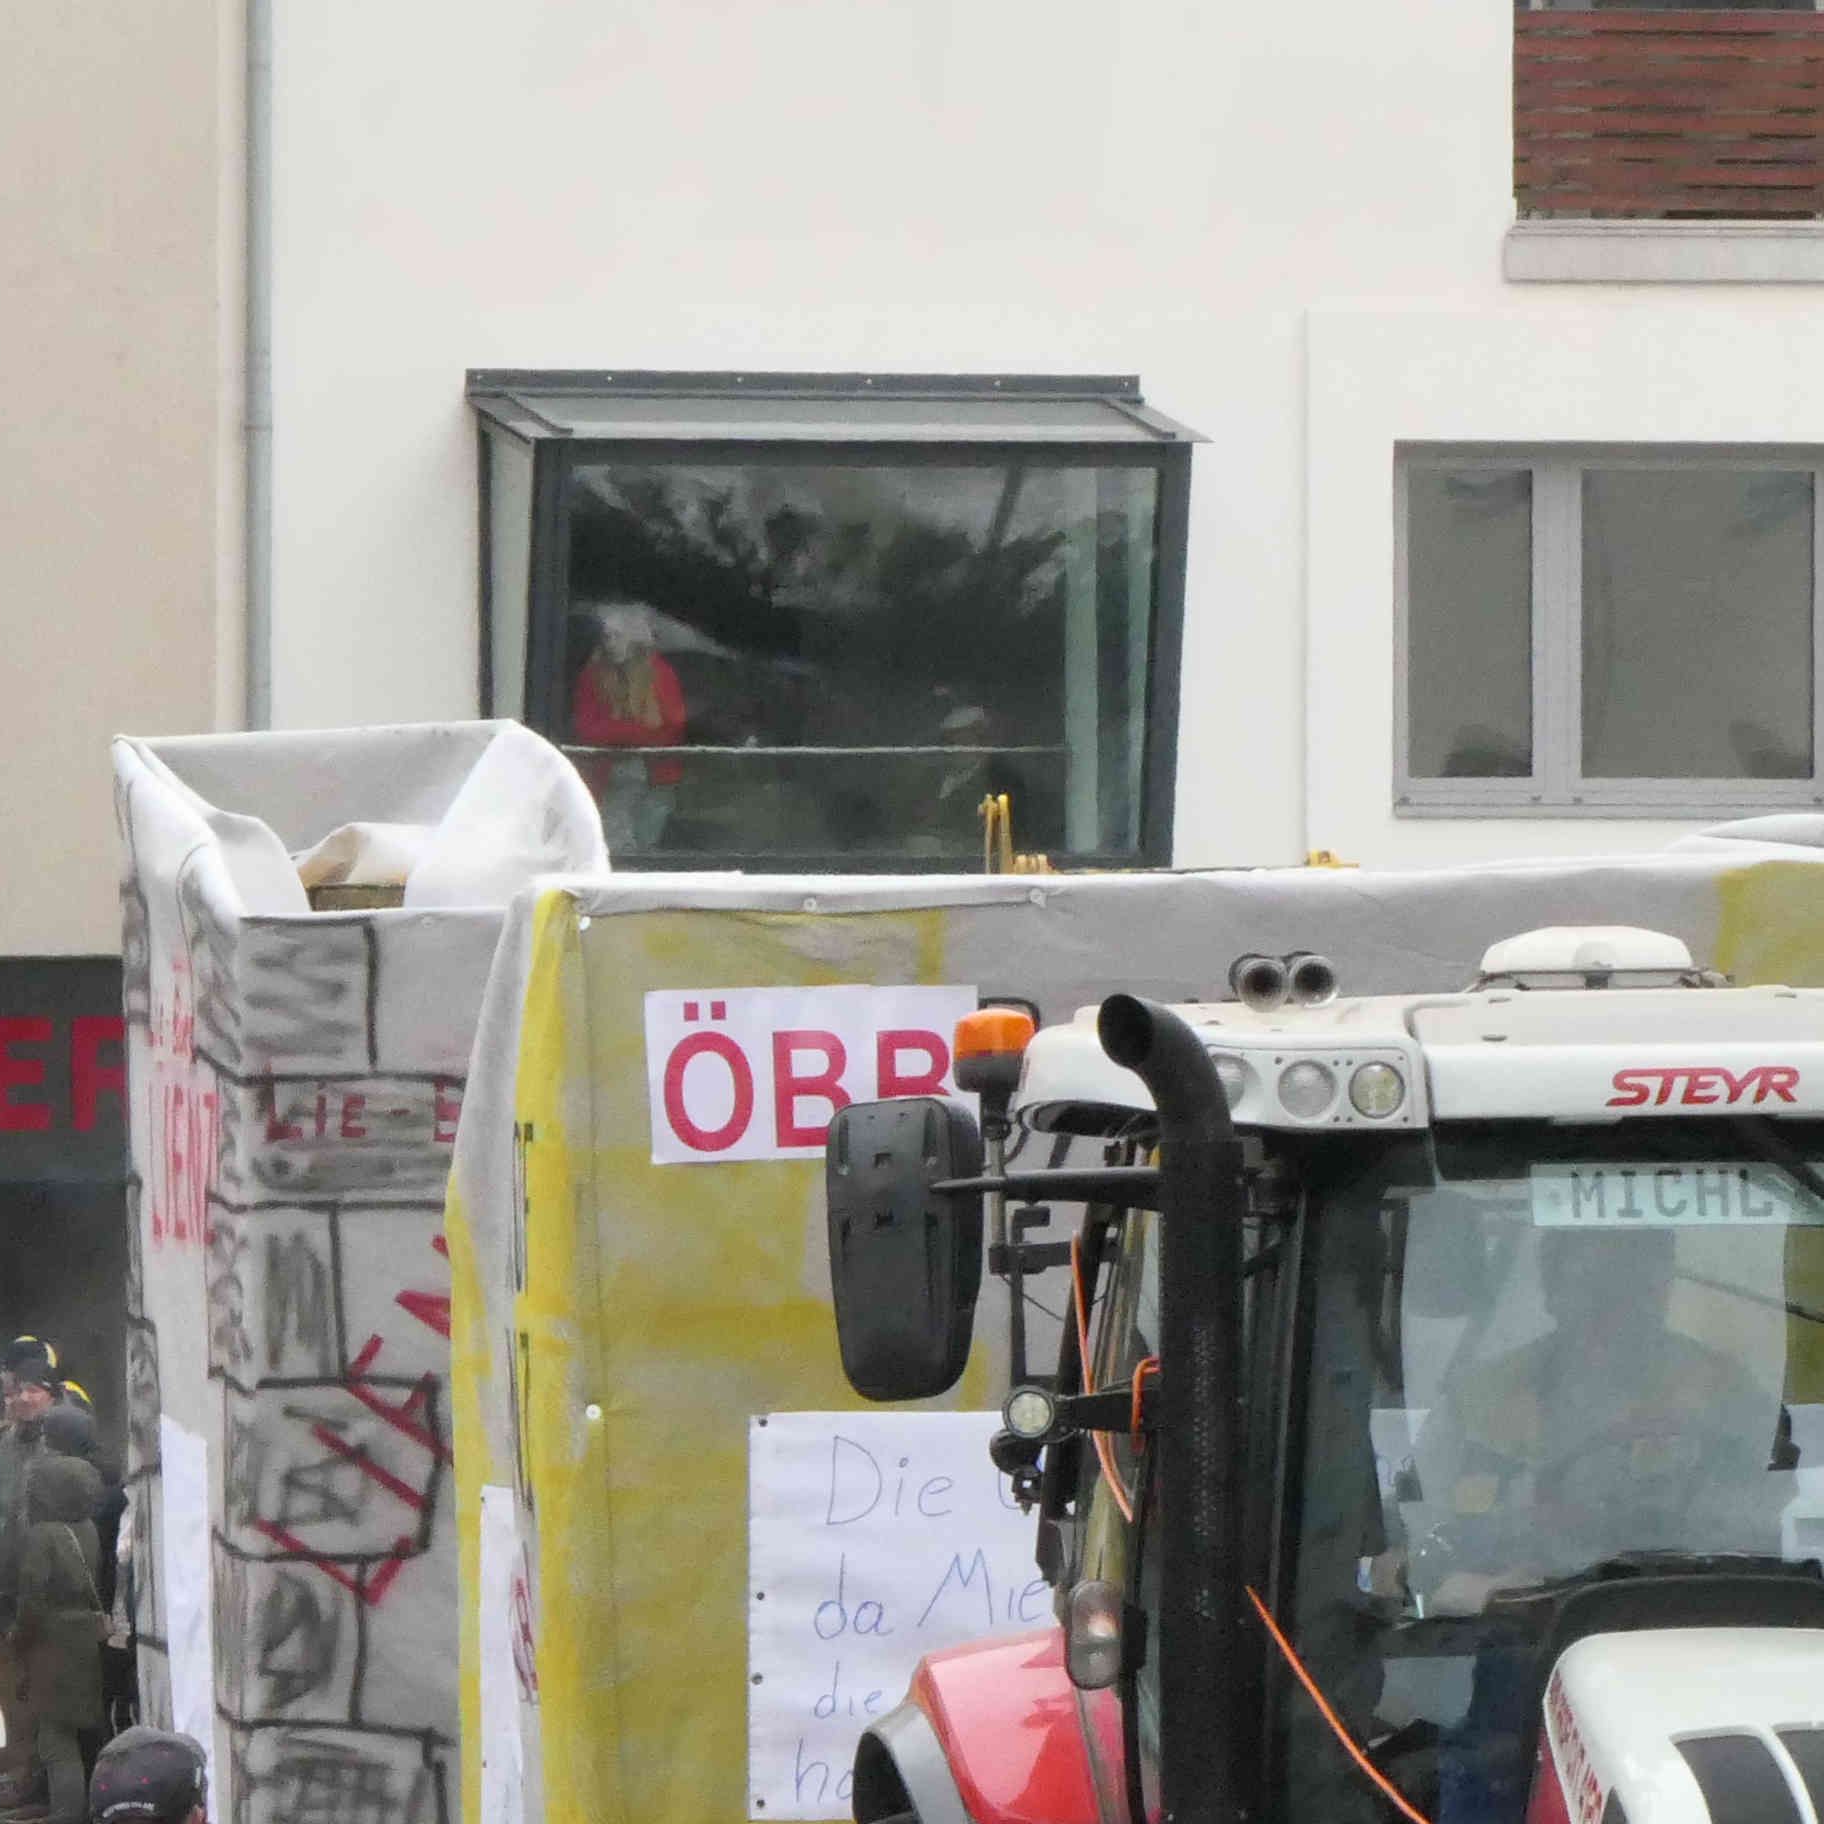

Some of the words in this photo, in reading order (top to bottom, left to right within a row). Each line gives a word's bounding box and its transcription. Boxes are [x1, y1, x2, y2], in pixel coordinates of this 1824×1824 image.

[1606, 1066, 1800, 1107] STEYR
[826, 1434, 953, 1526] Die
[813, 1552, 894, 1641] da
